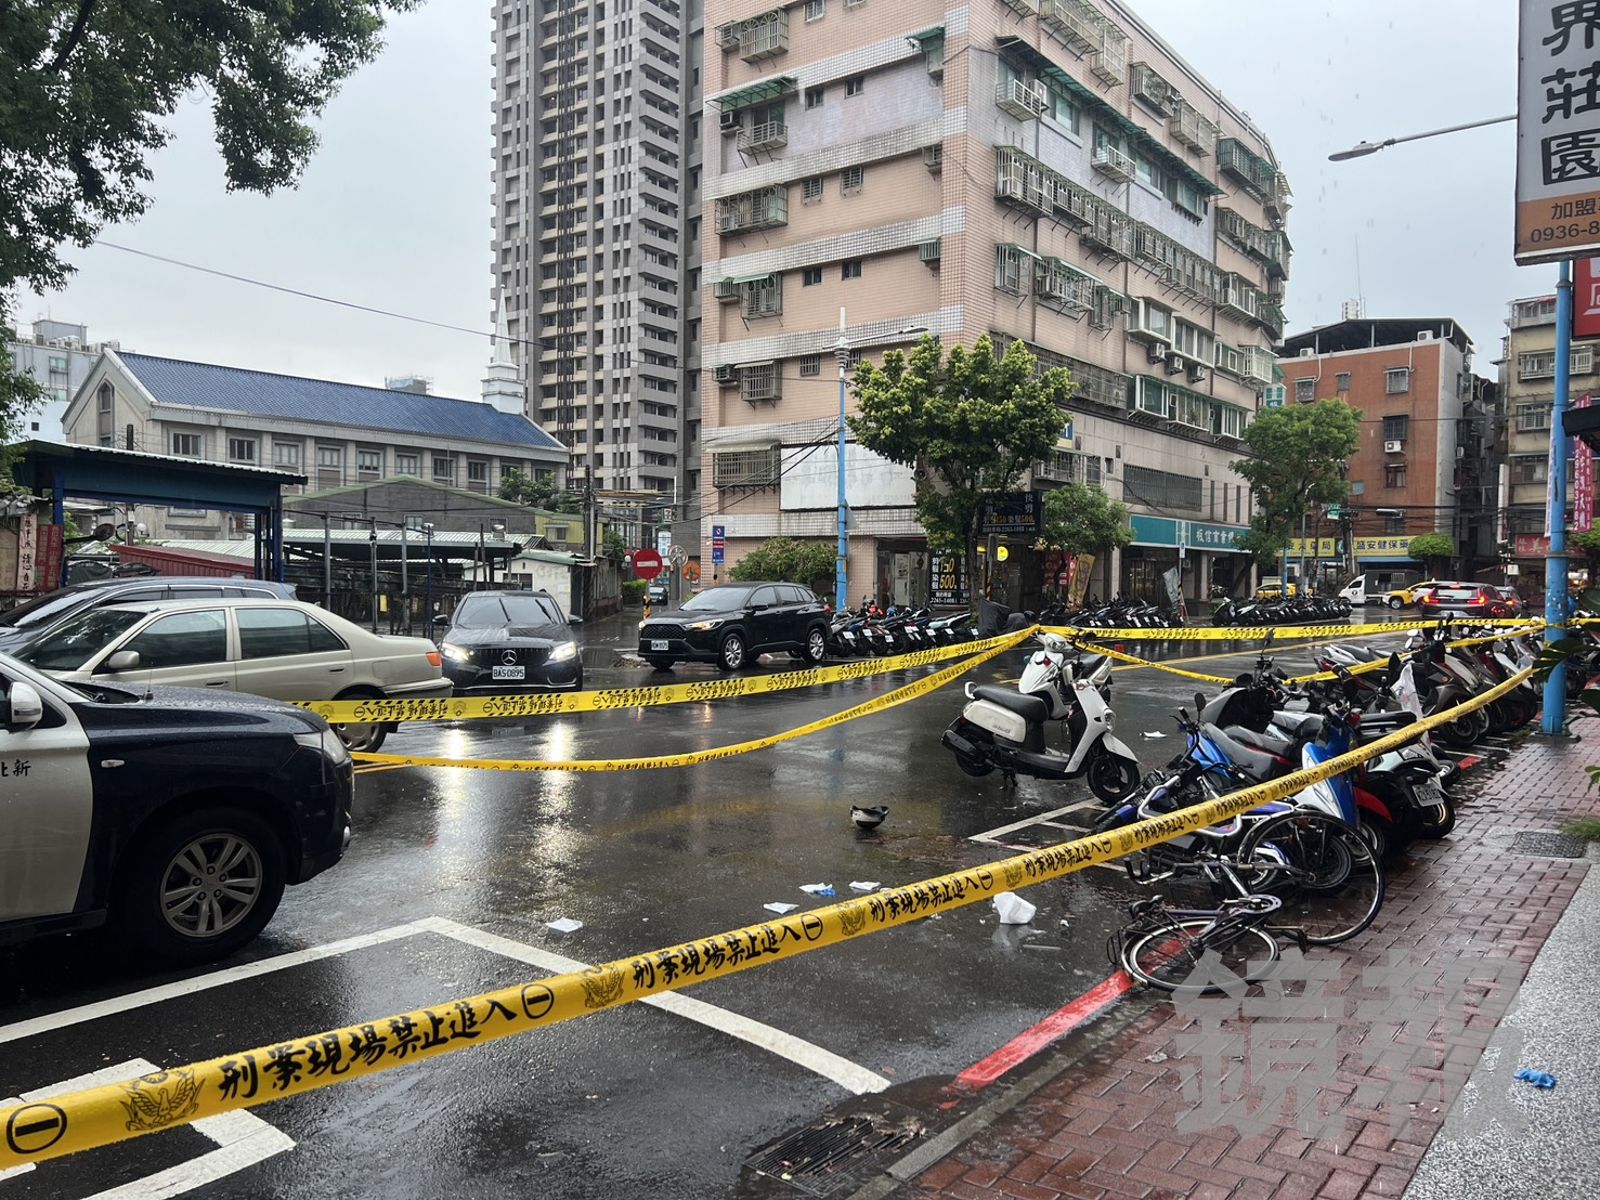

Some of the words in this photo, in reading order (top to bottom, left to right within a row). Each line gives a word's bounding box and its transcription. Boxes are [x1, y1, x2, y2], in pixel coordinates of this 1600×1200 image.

[1551, 199, 1600, 220] 加盟
[218, 998, 516, 1101] 刑案現場禁止進入
[632, 924, 801, 989] 刑案現場禁止進入
[871, 876, 979, 922] 刑案現場禁止進入
